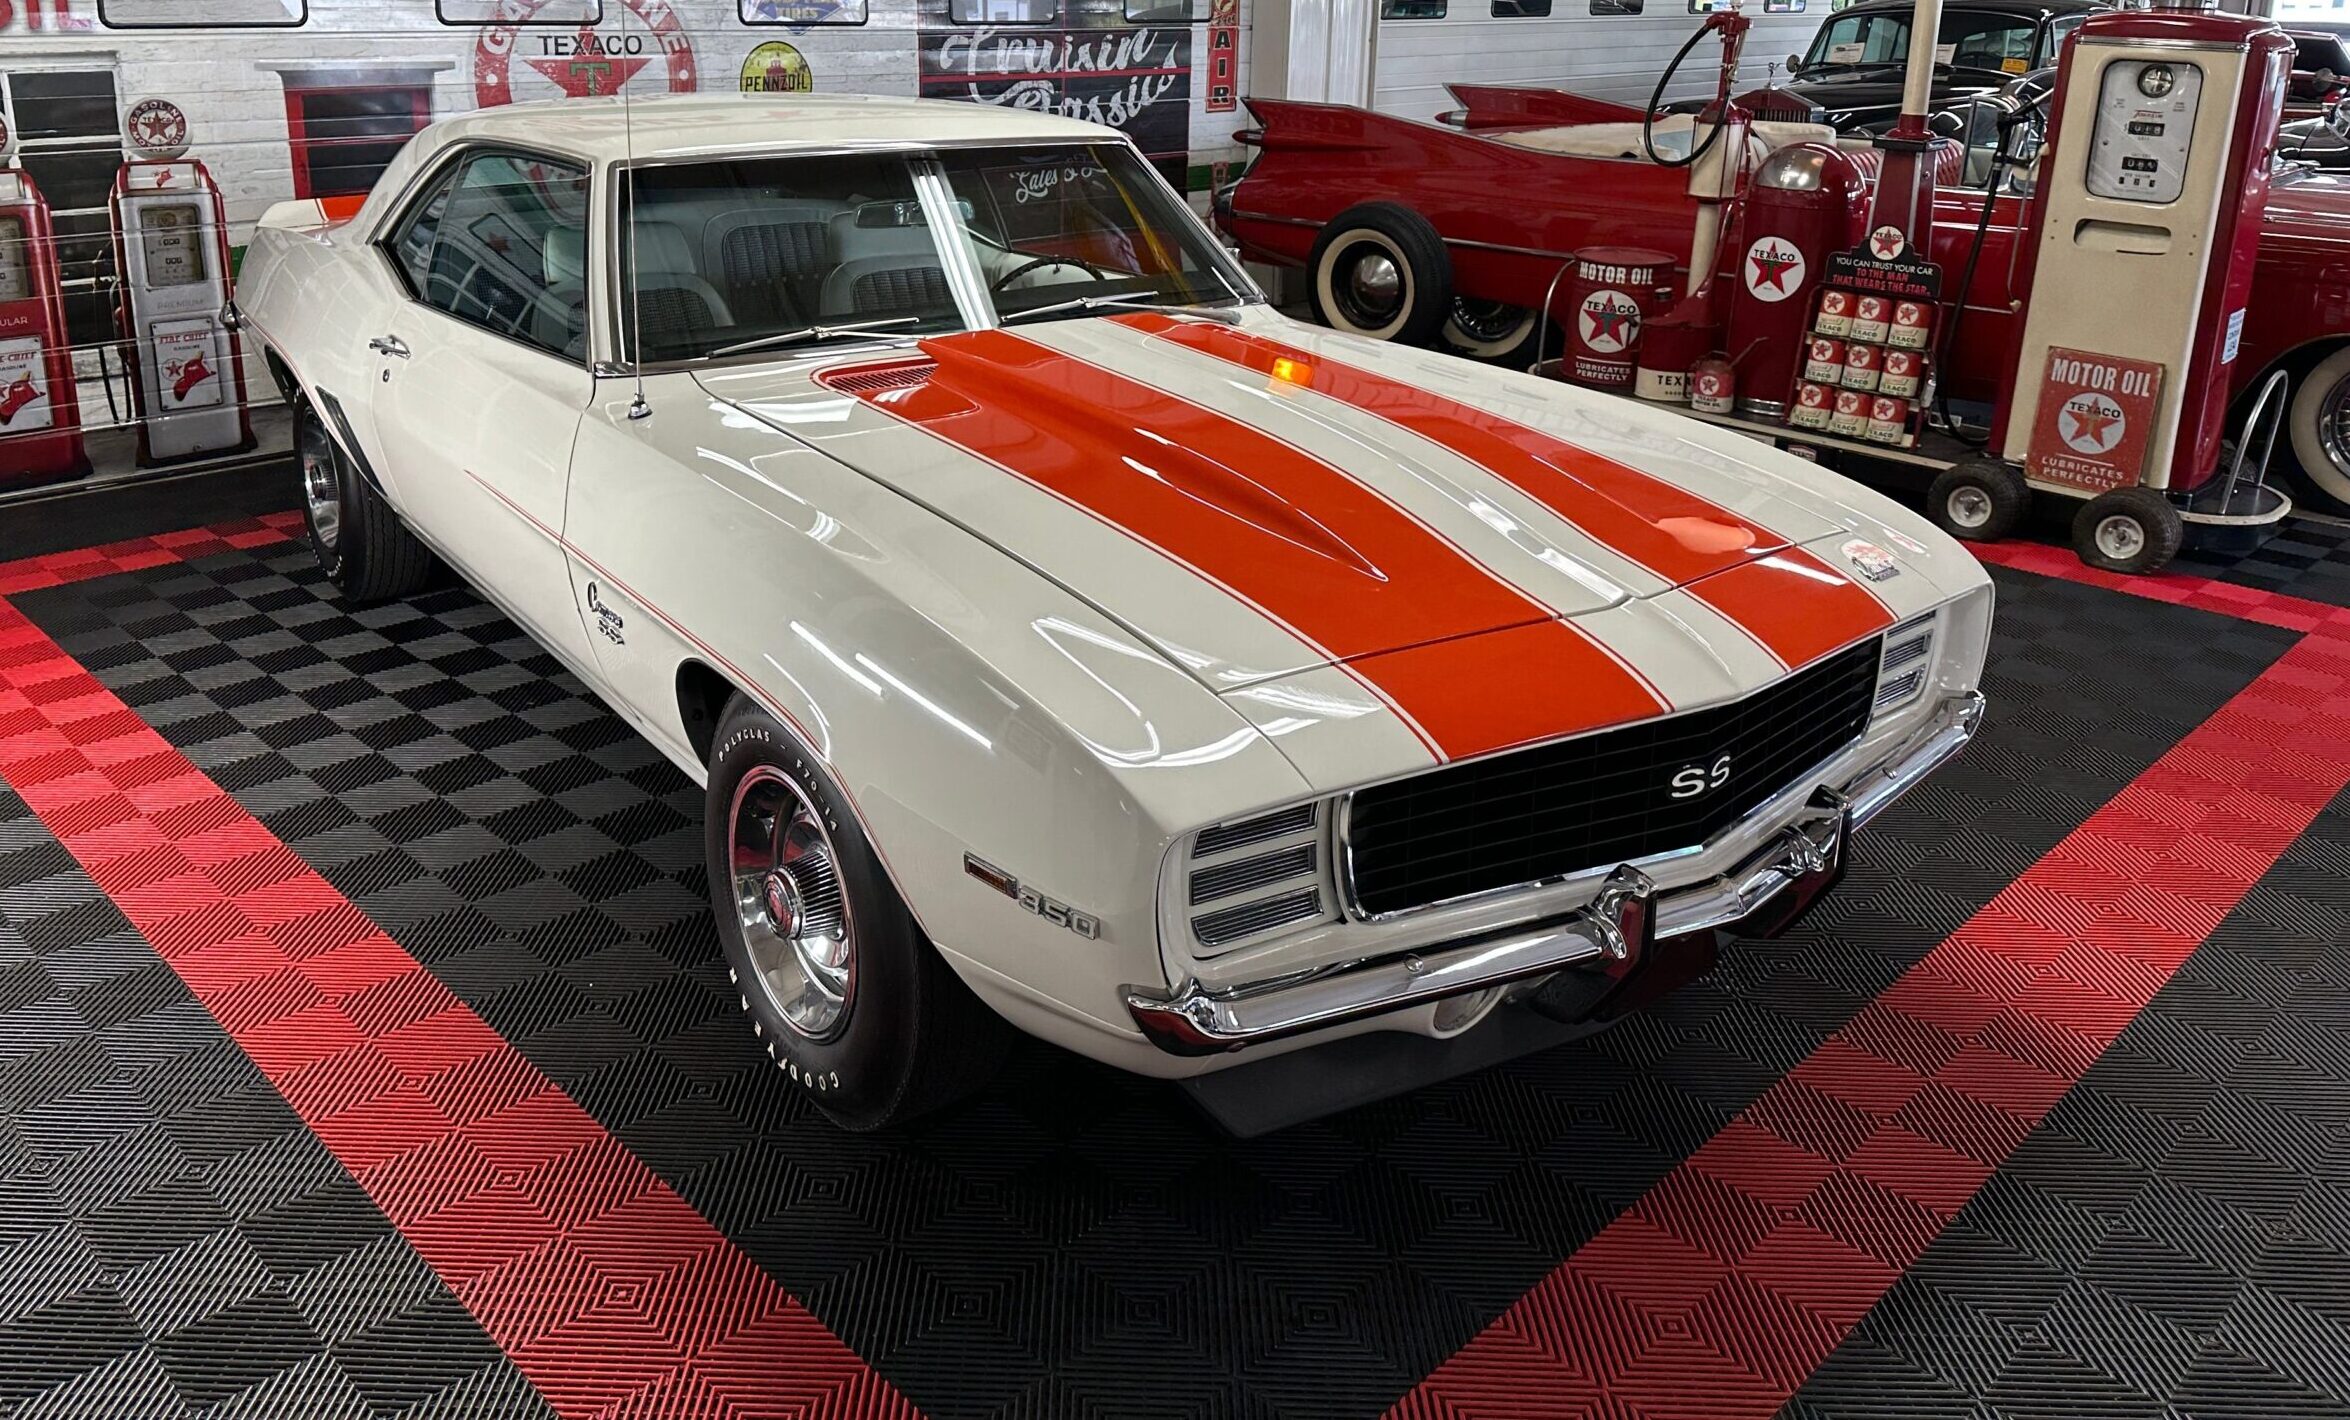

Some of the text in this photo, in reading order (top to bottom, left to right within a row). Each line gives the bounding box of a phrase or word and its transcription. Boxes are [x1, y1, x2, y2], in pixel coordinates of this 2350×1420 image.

[537, 35, 642, 56] TEXACO
[1213, 29, 1232, 105] AIR
[745, 74, 807, 92] PENNZOIL
[1009, 168, 1058, 203] Sales
[1754, 249, 1795, 261] TEXACO
[1579, 261, 1654, 285] MOTOR OIL
[1836, 256, 1933, 276] YOU CAN TRUST YOUR CAR
[1856, 268, 1909, 282] TO THE MAN
[1833, 274, 1853, 286] THAT
[1855, 278, 1886, 291] WEARS
[1888, 281, 1904, 293] THE
[1587, 300, 1636, 314] TEXACO
[1575, 361, 1631, 375] LUBRICATES
[1576, 369, 1628, 381] PERFECTLY
[2051, 358, 2151, 397] MOTOR OIL
[2069, 401, 2121, 418] TEXACO
[2042, 456, 2124, 480] LUBRICATES
[2043, 467, 2119, 489] PERFECTLY
[718, 728, 770, 762] POLYGLAS
[1671, 755, 1730, 798] SS
[1018, 884, 1100, 940] 350
